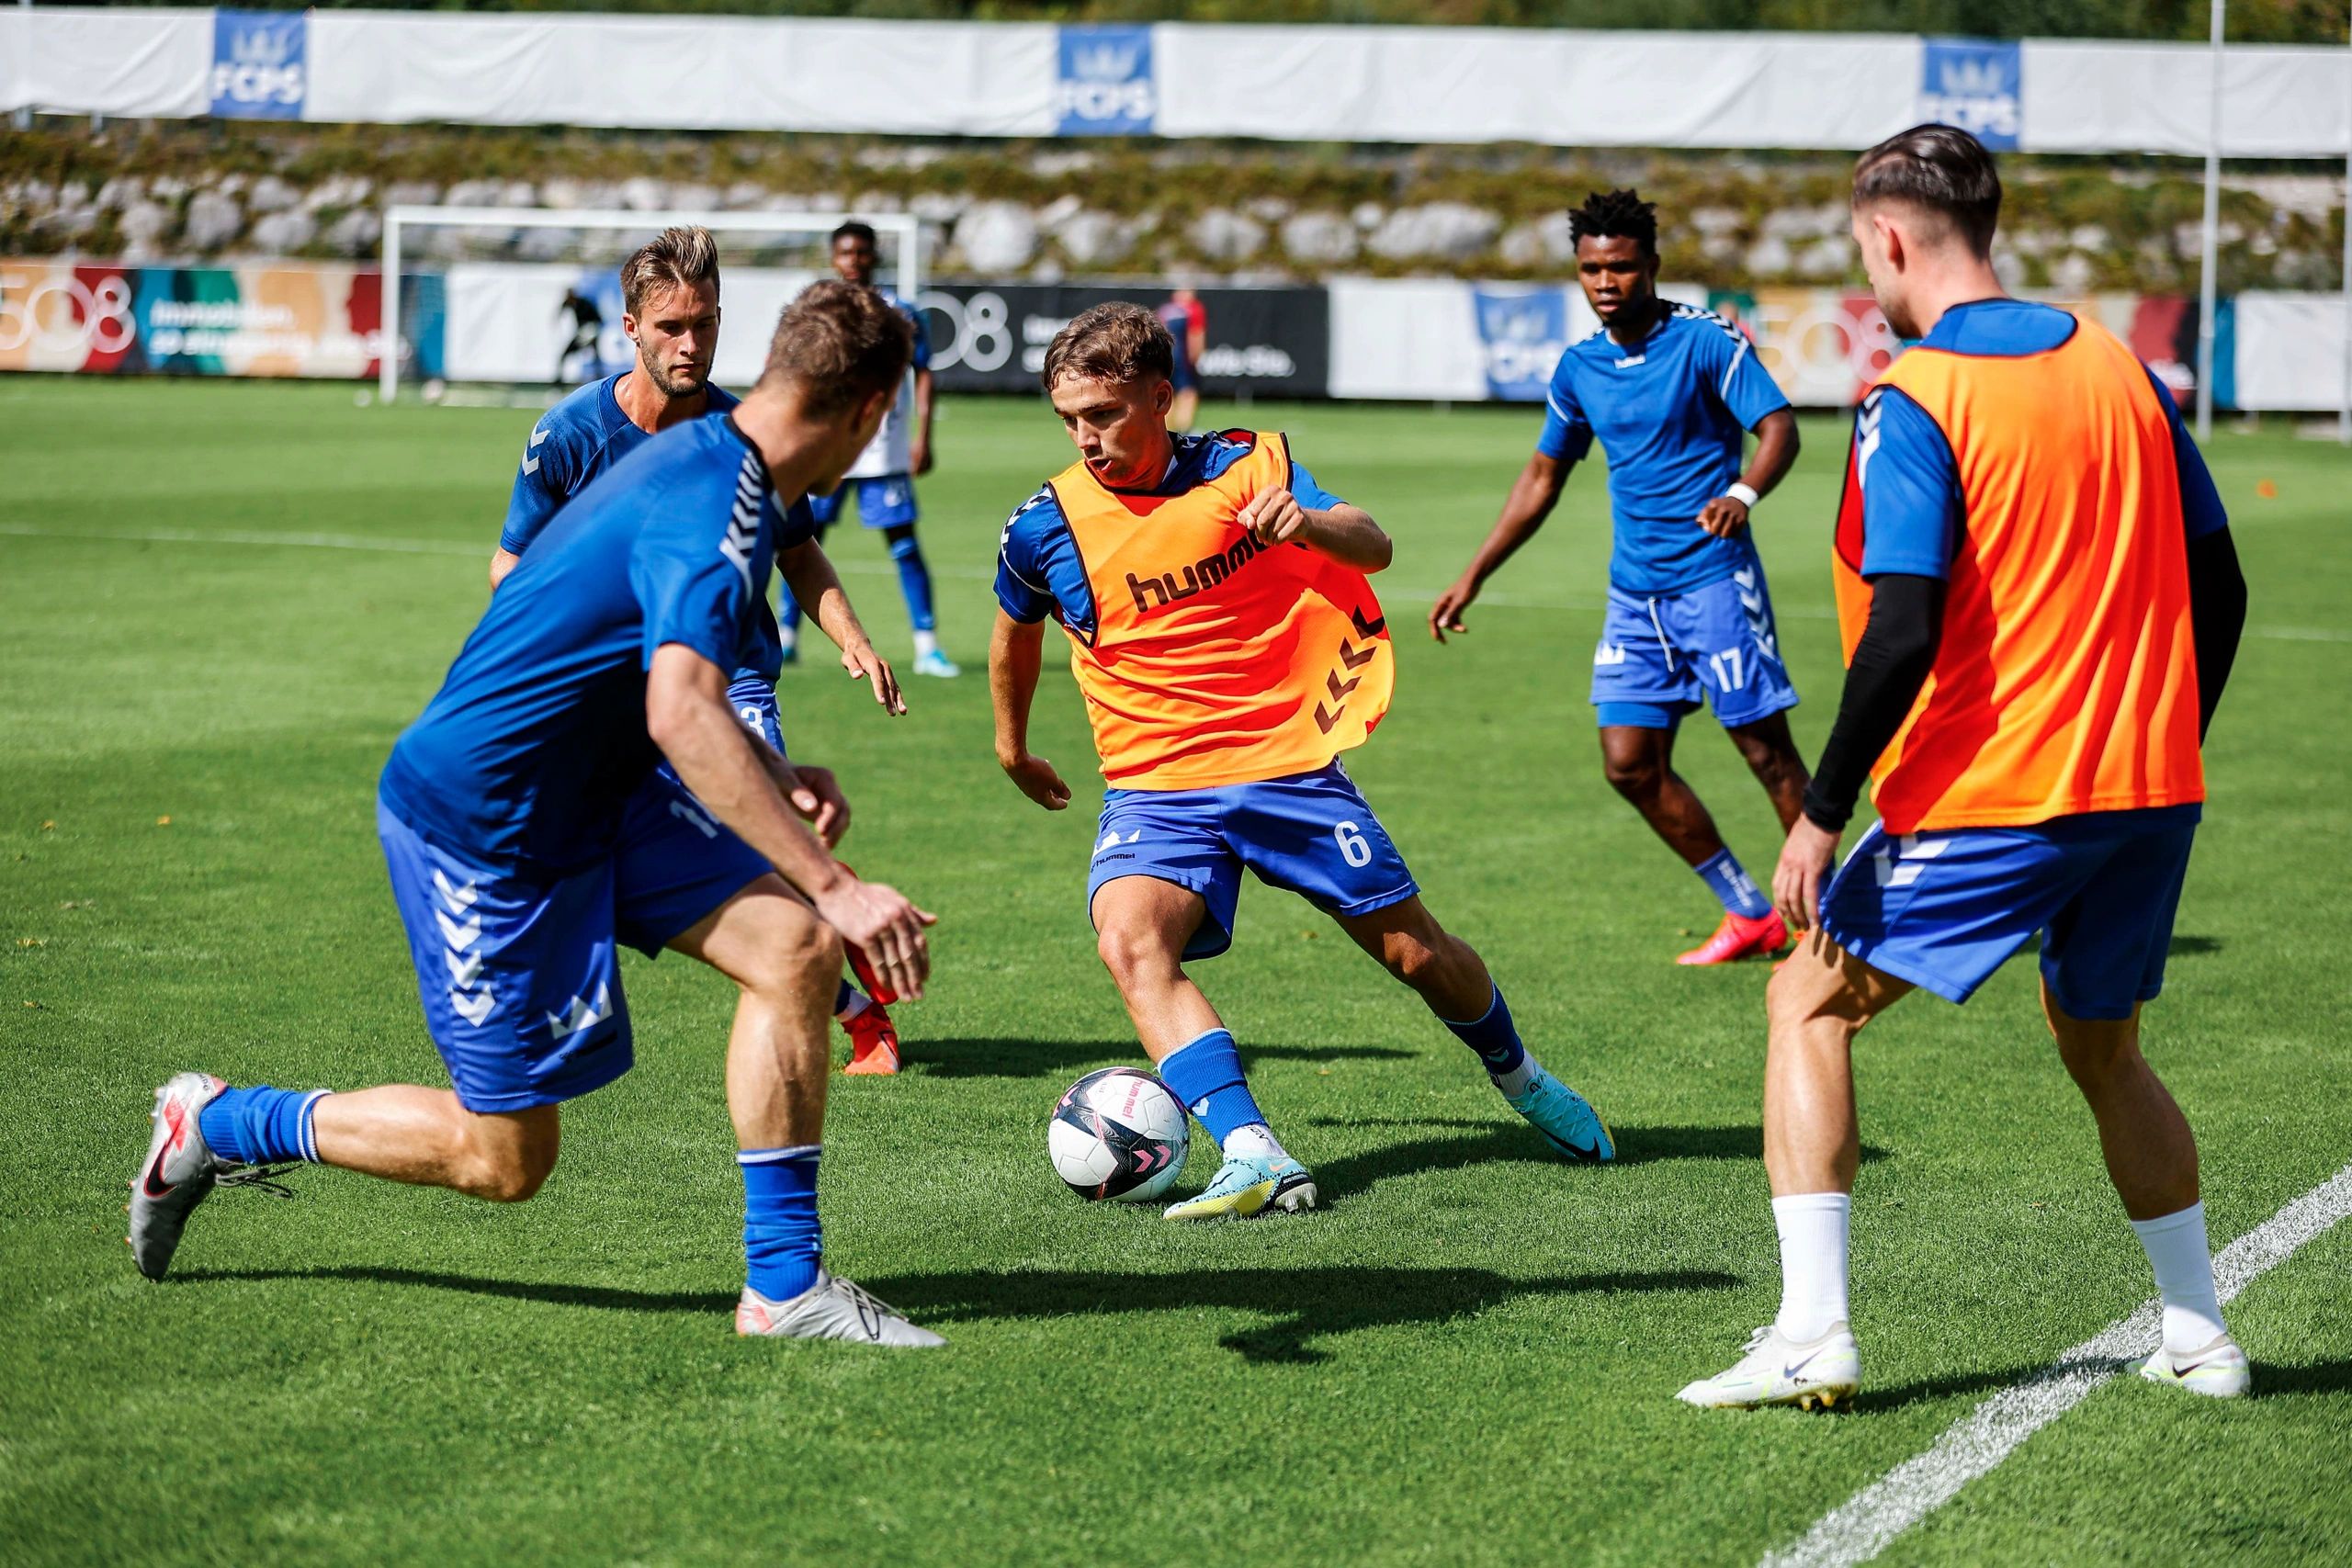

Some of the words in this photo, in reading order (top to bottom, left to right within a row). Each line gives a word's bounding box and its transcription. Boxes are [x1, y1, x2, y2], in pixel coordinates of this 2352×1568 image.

[211, 62, 305, 105] FCPS
[919, 290, 1013, 372] 08
[1126, 528, 1272, 613] humm
[1709, 646, 1744, 693] 17
[1096, 852, 1136, 867] hummel
[1334, 820, 1372, 868] 6
[1122, 1078, 1147, 1120] hummel
